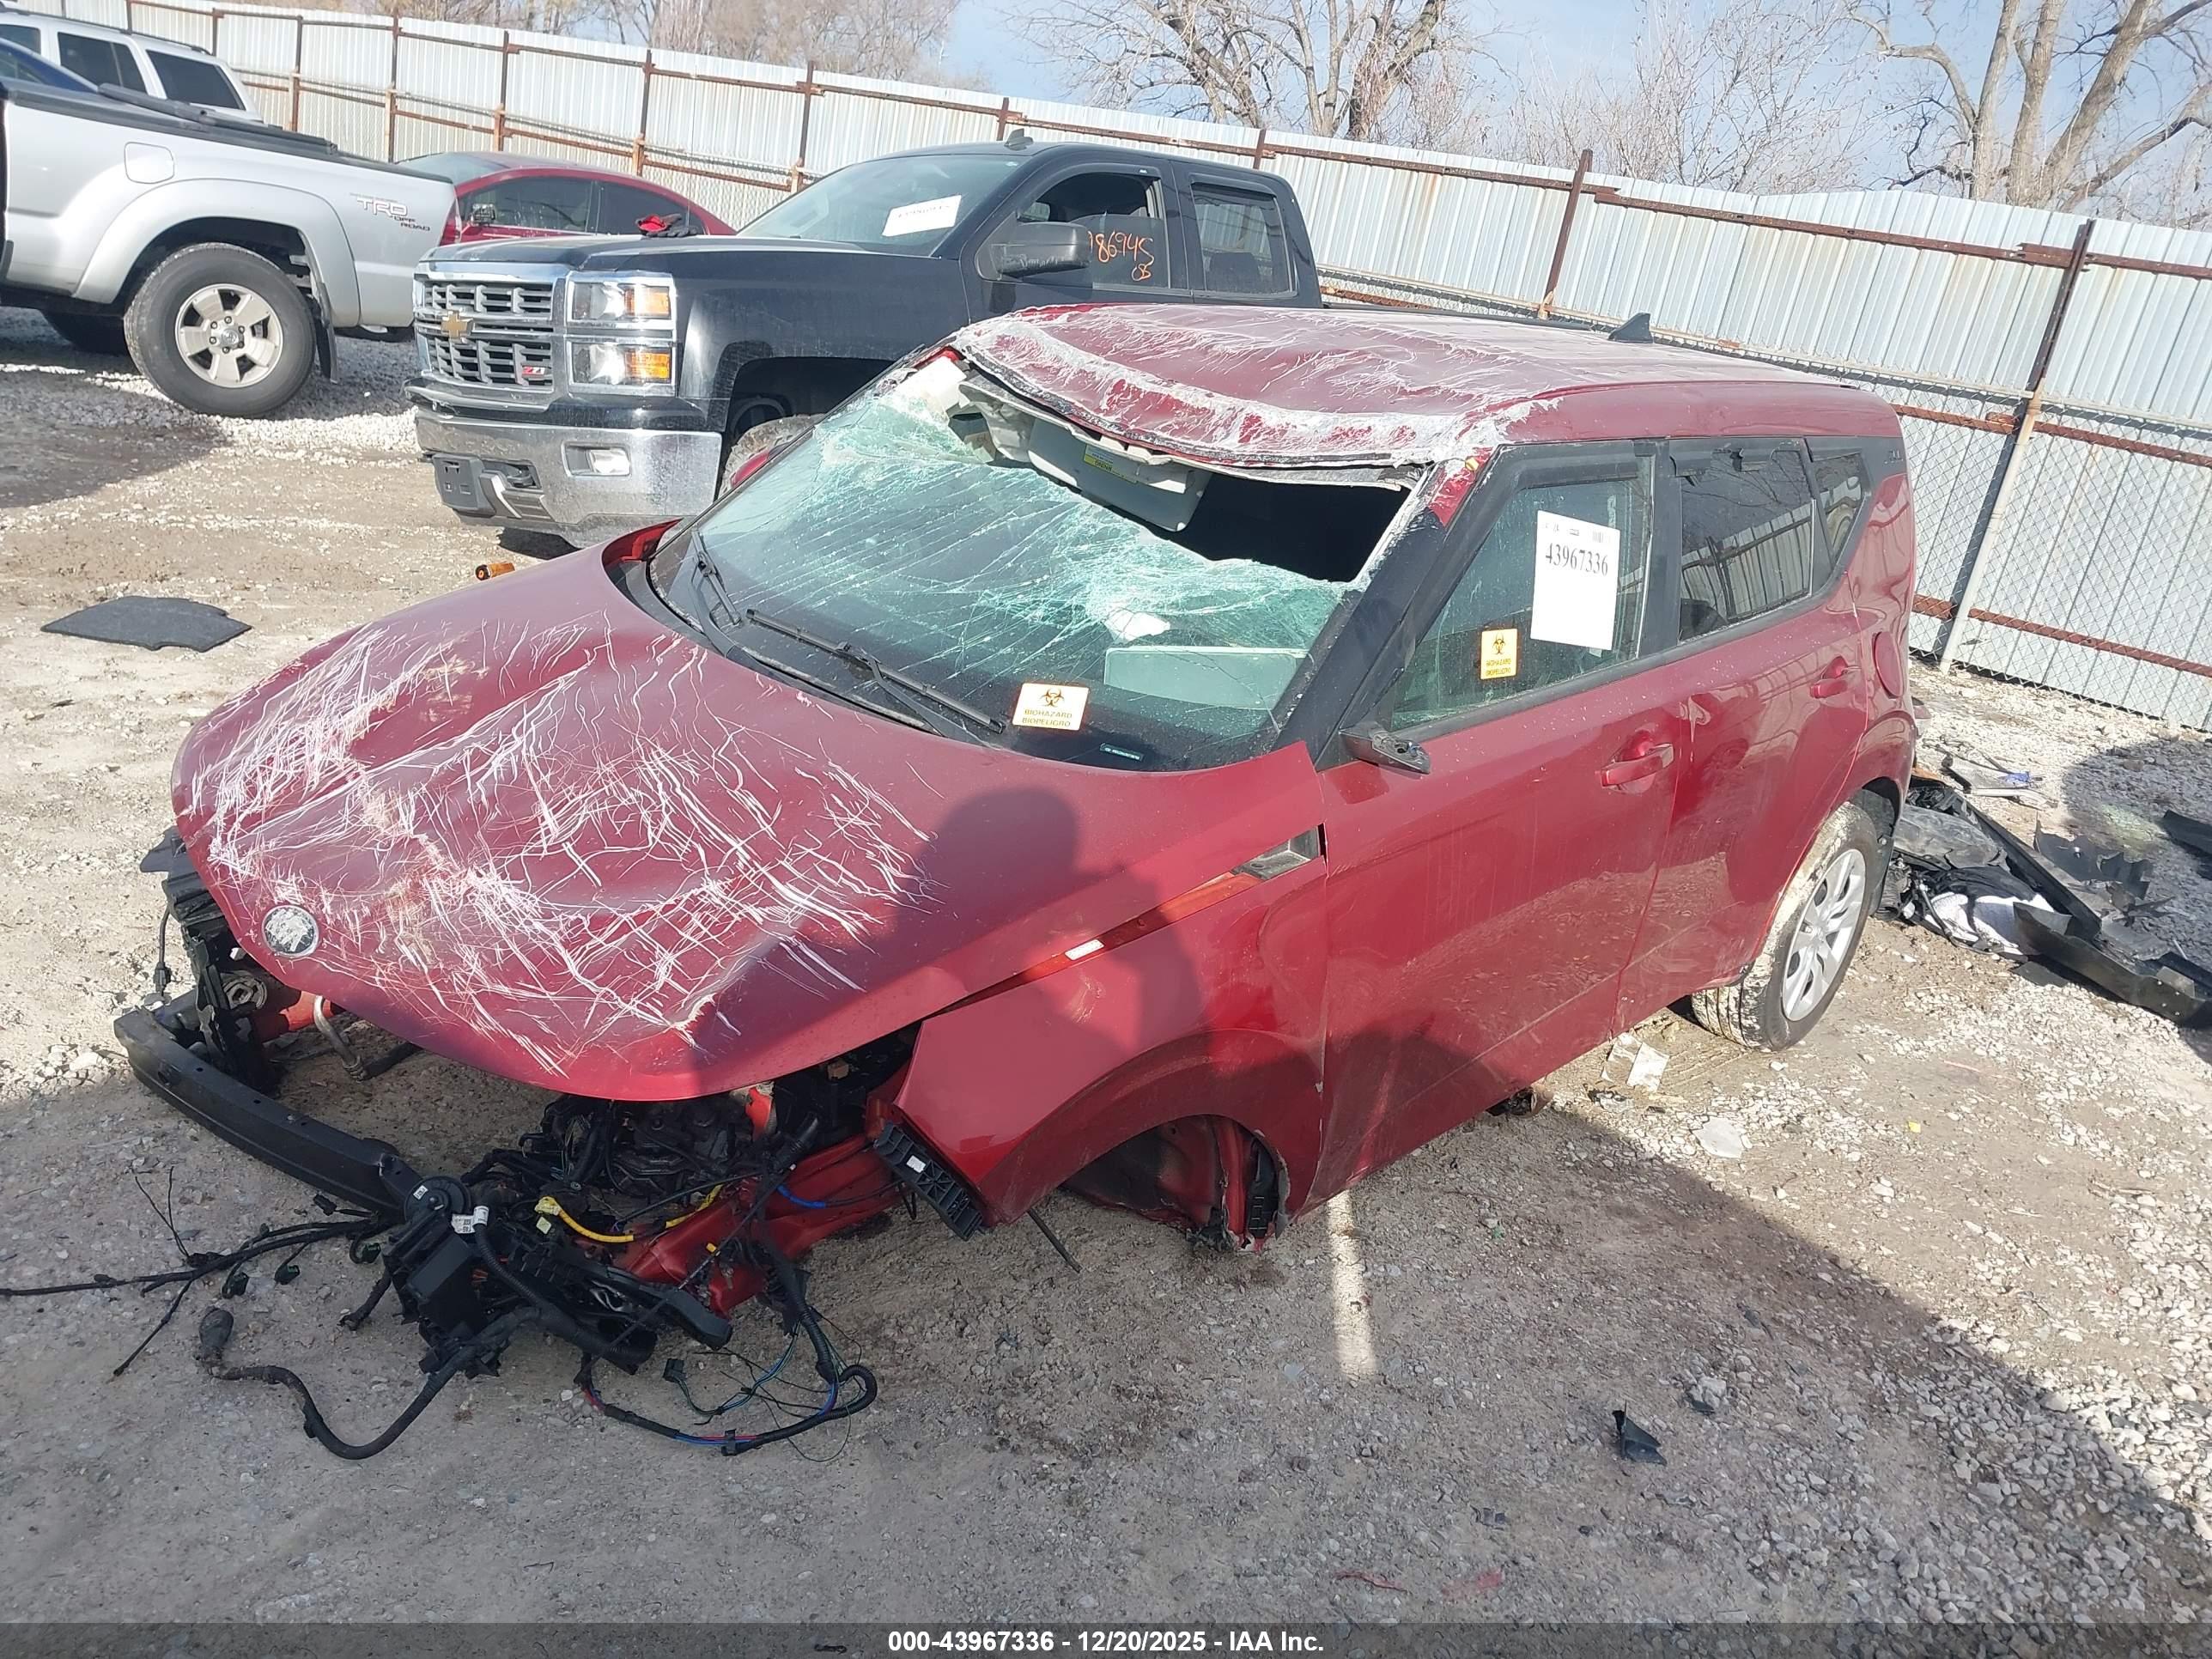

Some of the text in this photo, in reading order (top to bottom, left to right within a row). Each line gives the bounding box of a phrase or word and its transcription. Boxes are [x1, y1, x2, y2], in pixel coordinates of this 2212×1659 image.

[356, 197, 408, 216] TRD
[400, 222, 431, 232] ROAD
[1545, 543, 1608, 576] 43967336
[1024, 708, 1073, 718] BIOHAZARD
[1022, 717, 1071, 727] BIOPELIGRO
